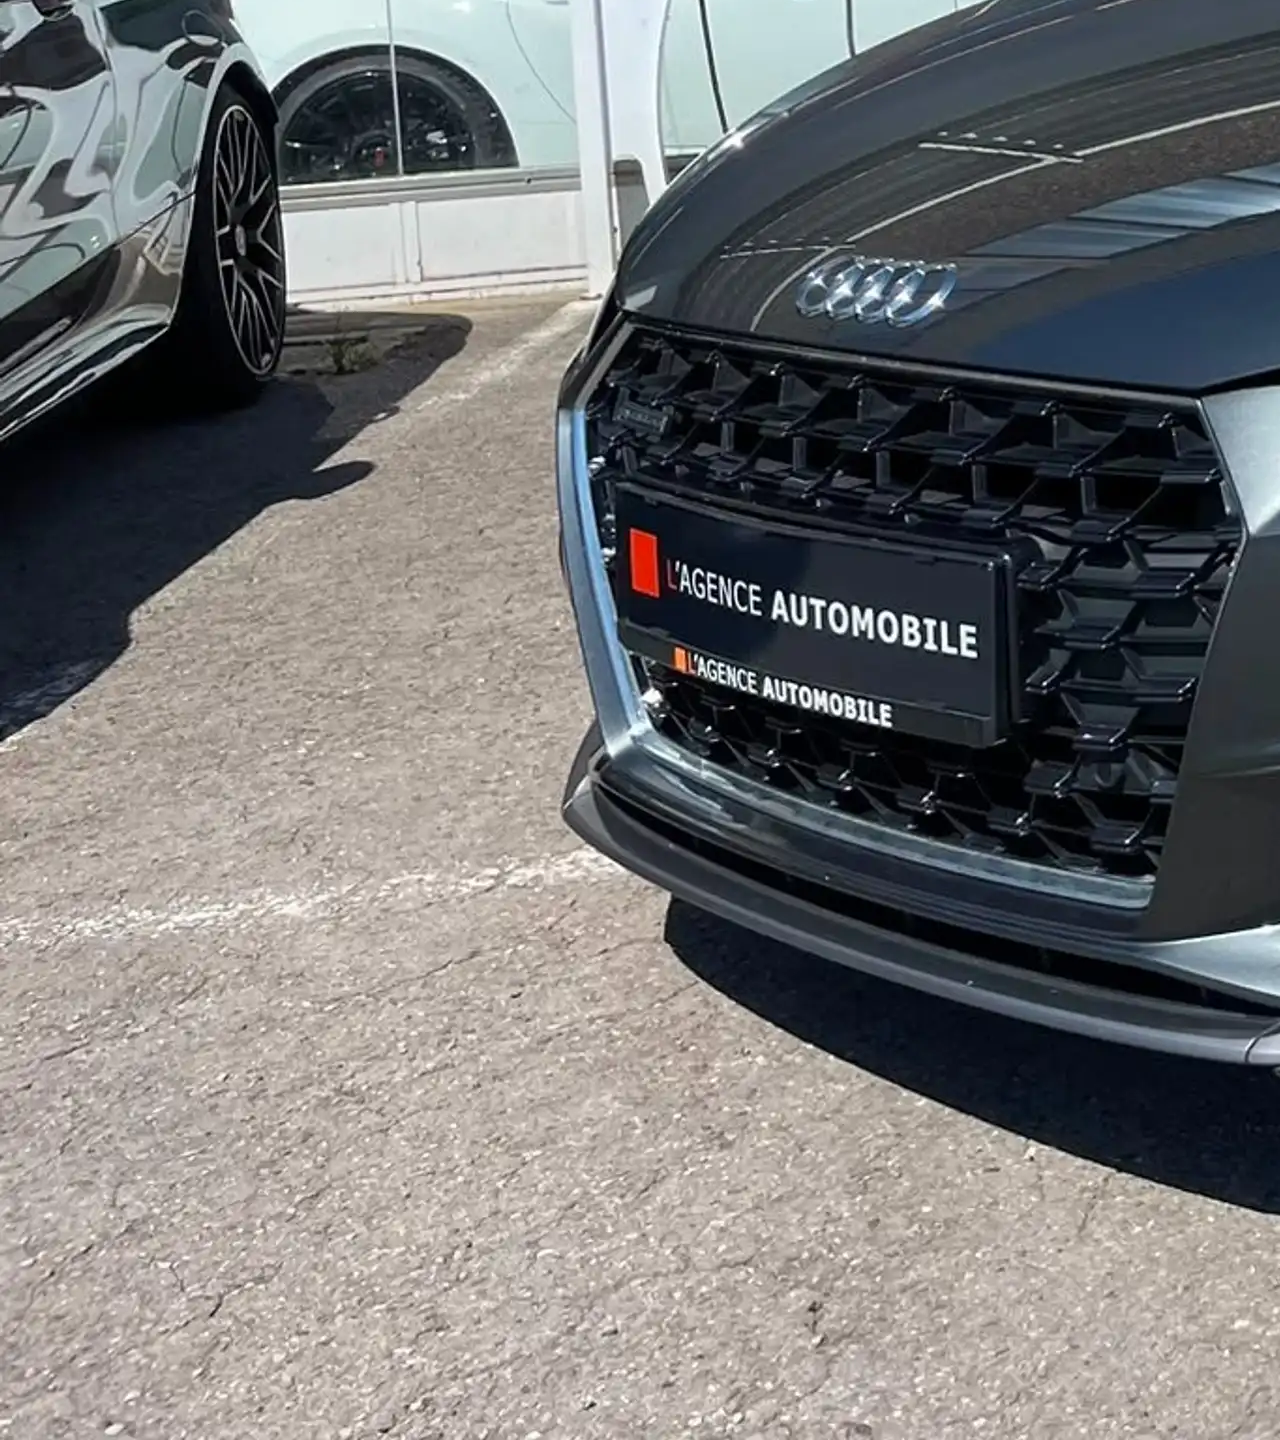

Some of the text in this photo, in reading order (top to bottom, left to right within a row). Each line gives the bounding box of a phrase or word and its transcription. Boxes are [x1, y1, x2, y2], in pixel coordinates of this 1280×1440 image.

[666, 558, 979, 659] L'AGENCE AUTOMOBILE
[685, 652, 893, 729] L'AGENCE AUTOMOBILE
